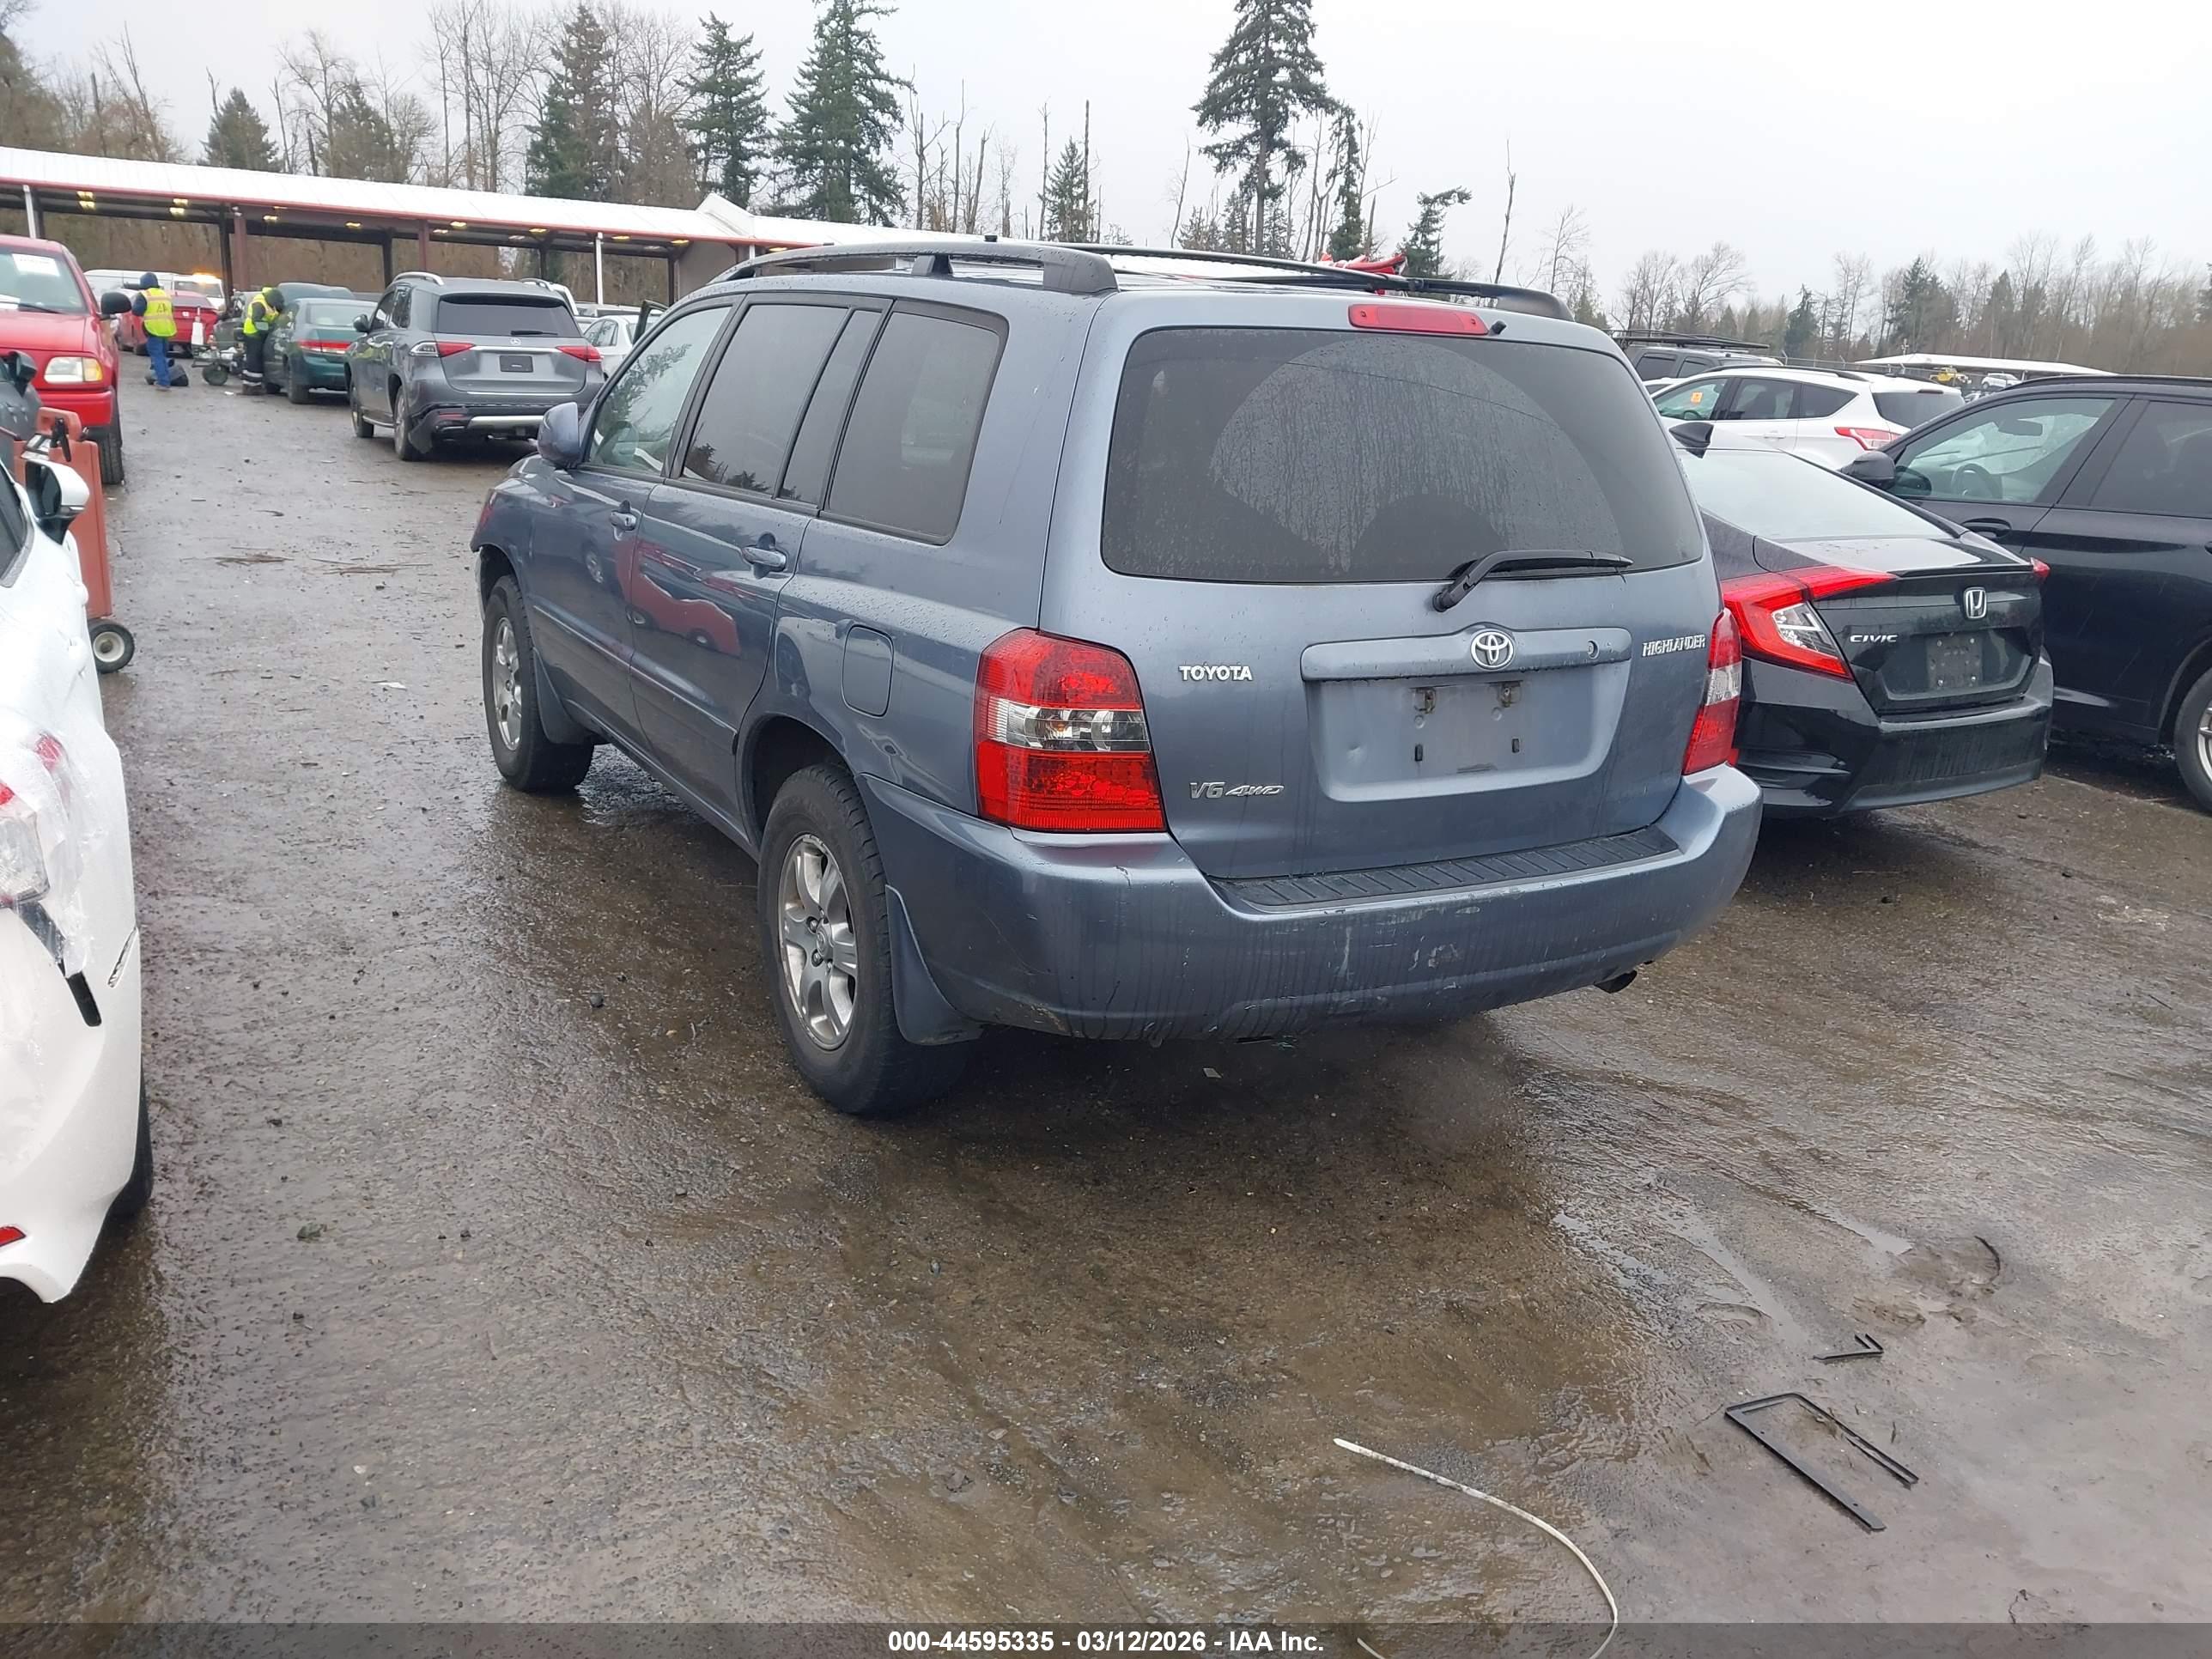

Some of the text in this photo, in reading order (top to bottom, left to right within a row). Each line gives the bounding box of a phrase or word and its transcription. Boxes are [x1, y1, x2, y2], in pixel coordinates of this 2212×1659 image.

[1642, 634, 1706, 658] HIGHLANDER
[1849, 634, 1899, 643] CIVIC
[1178, 665, 1253, 681] TOYOTA
[1189, 781, 1285, 799] V6 4WD
